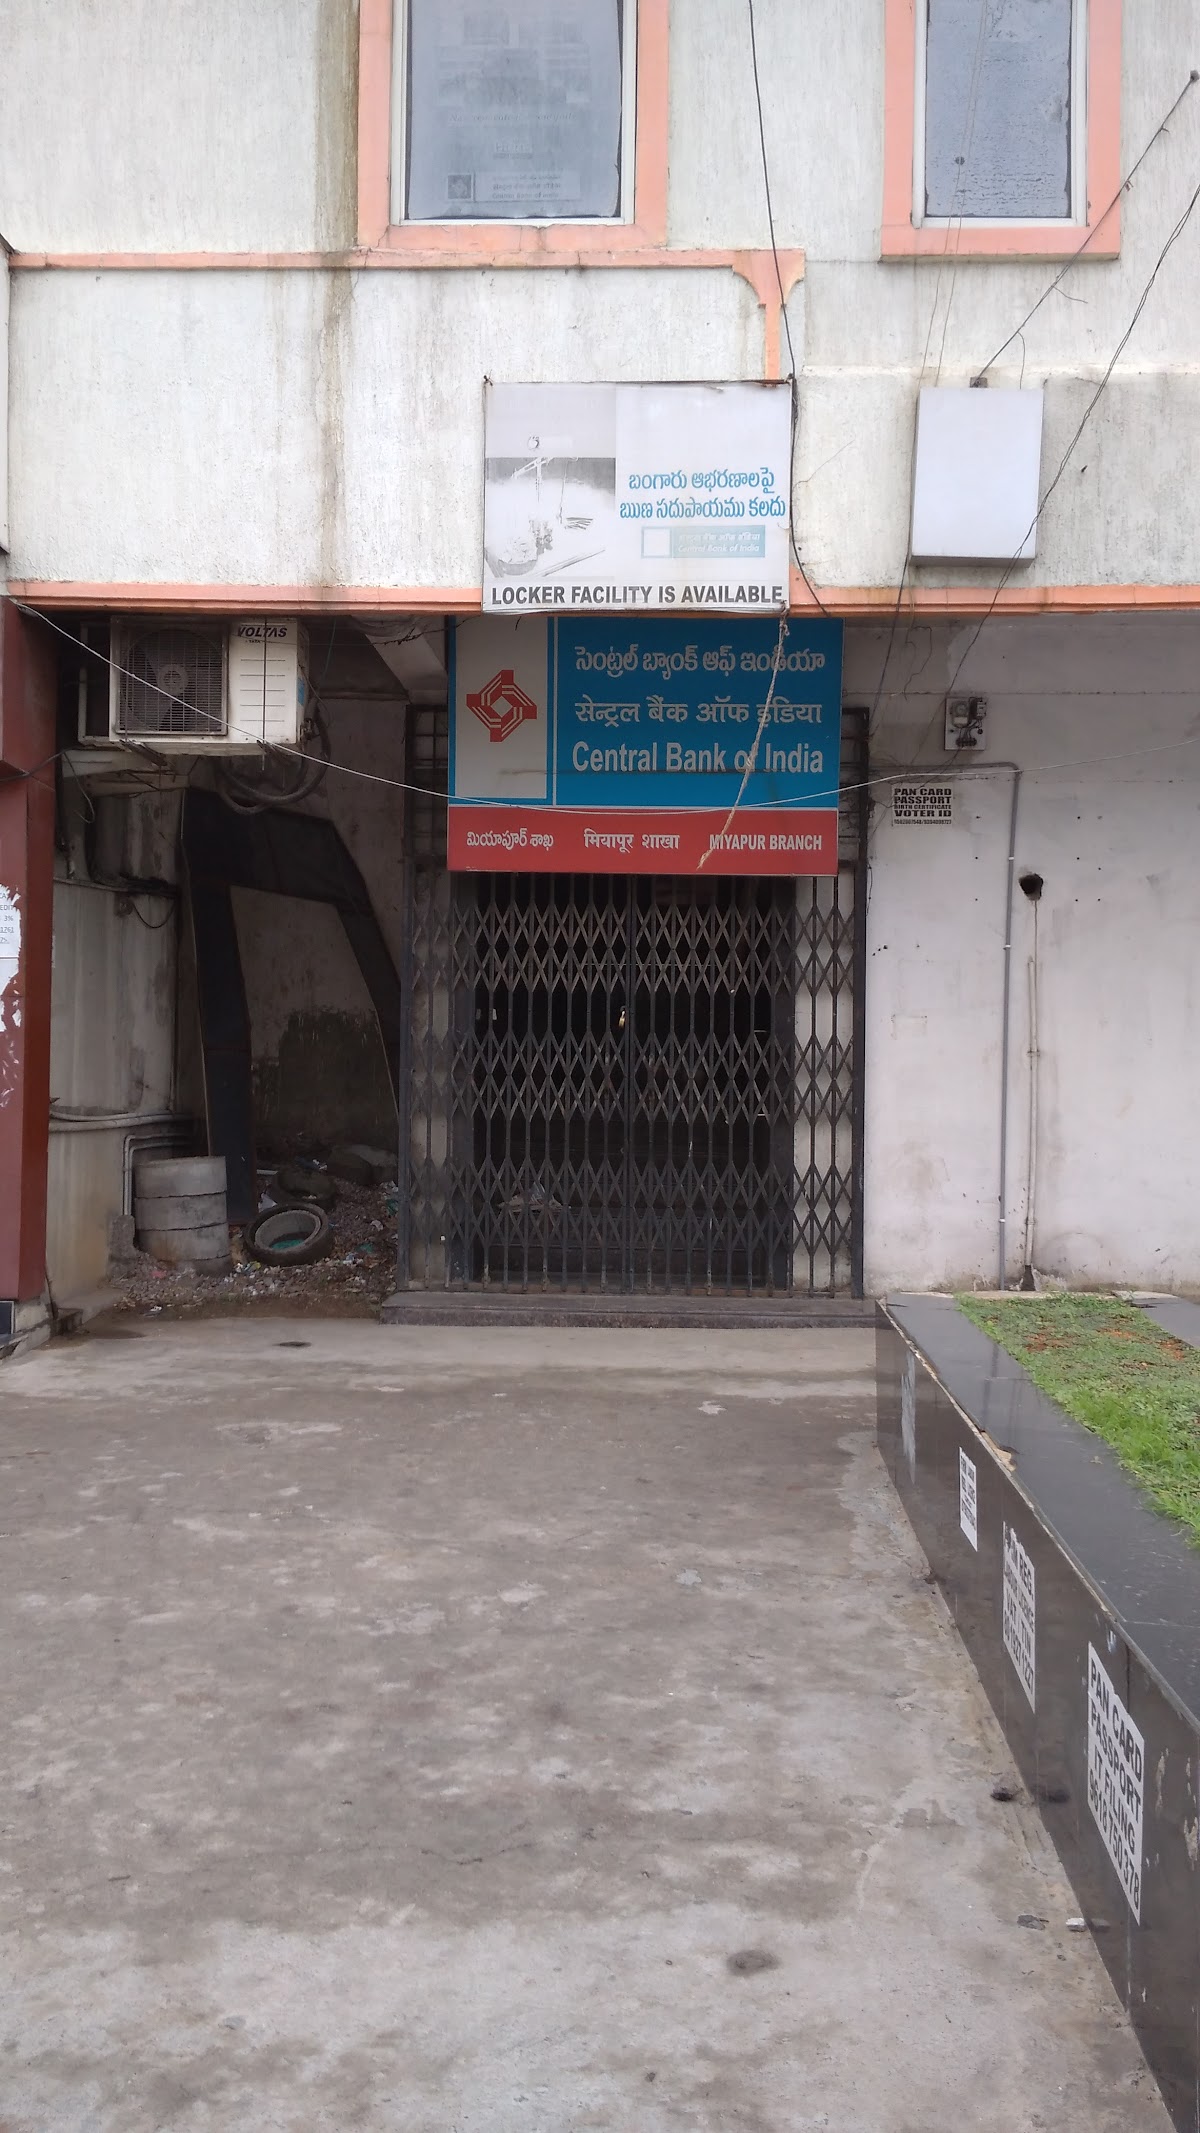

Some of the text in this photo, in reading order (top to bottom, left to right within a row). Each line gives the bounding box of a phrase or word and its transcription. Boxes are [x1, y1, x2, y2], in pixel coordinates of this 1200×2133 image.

[629, 467, 775, 494] బంగారు ఆభరణాలపై
[656, 497, 745, 518] సదుపాయము
[748, 496, 786, 518] కలదు
[707, 544, 727, 552] Bank
[729, 544, 739, 552] of
[739, 543, 760, 552] India
[492, 585, 783, 605] LOCKER FACILITY IS AVAILABLE
[237, 627, 288, 637] VOLTAS
[574, 644, 826, 680] సెంట్రల్ బ్యాంక్ ఆఫ్ ఇండియా
[574, 694, 641, 728] सेन्ट्रल
[645, 694, 688, 722] बैंक
[696, 696, 750, 723] ऑफ
[572, 741, 657, 772] Central
[666, 742, 727, 772] Bank
[765, 743, 823, 773] India
[894, 788, 952, 796] PAN CARD
[894, 796, 952, 804] PASSPORT
[466, 828, 554, 851] మియాపూర్ శాఖ
[584, 828, 680, 853] मियापूर शाखा
[709, 834, 822, 850] MIYAPUR BRANCH
[1091, 1657, 1142, 1785] PAN CARD
[1090, 1698, 1141, 1826] PASSPORT
[1094, 1744, 1135, 1857] IT FILING
